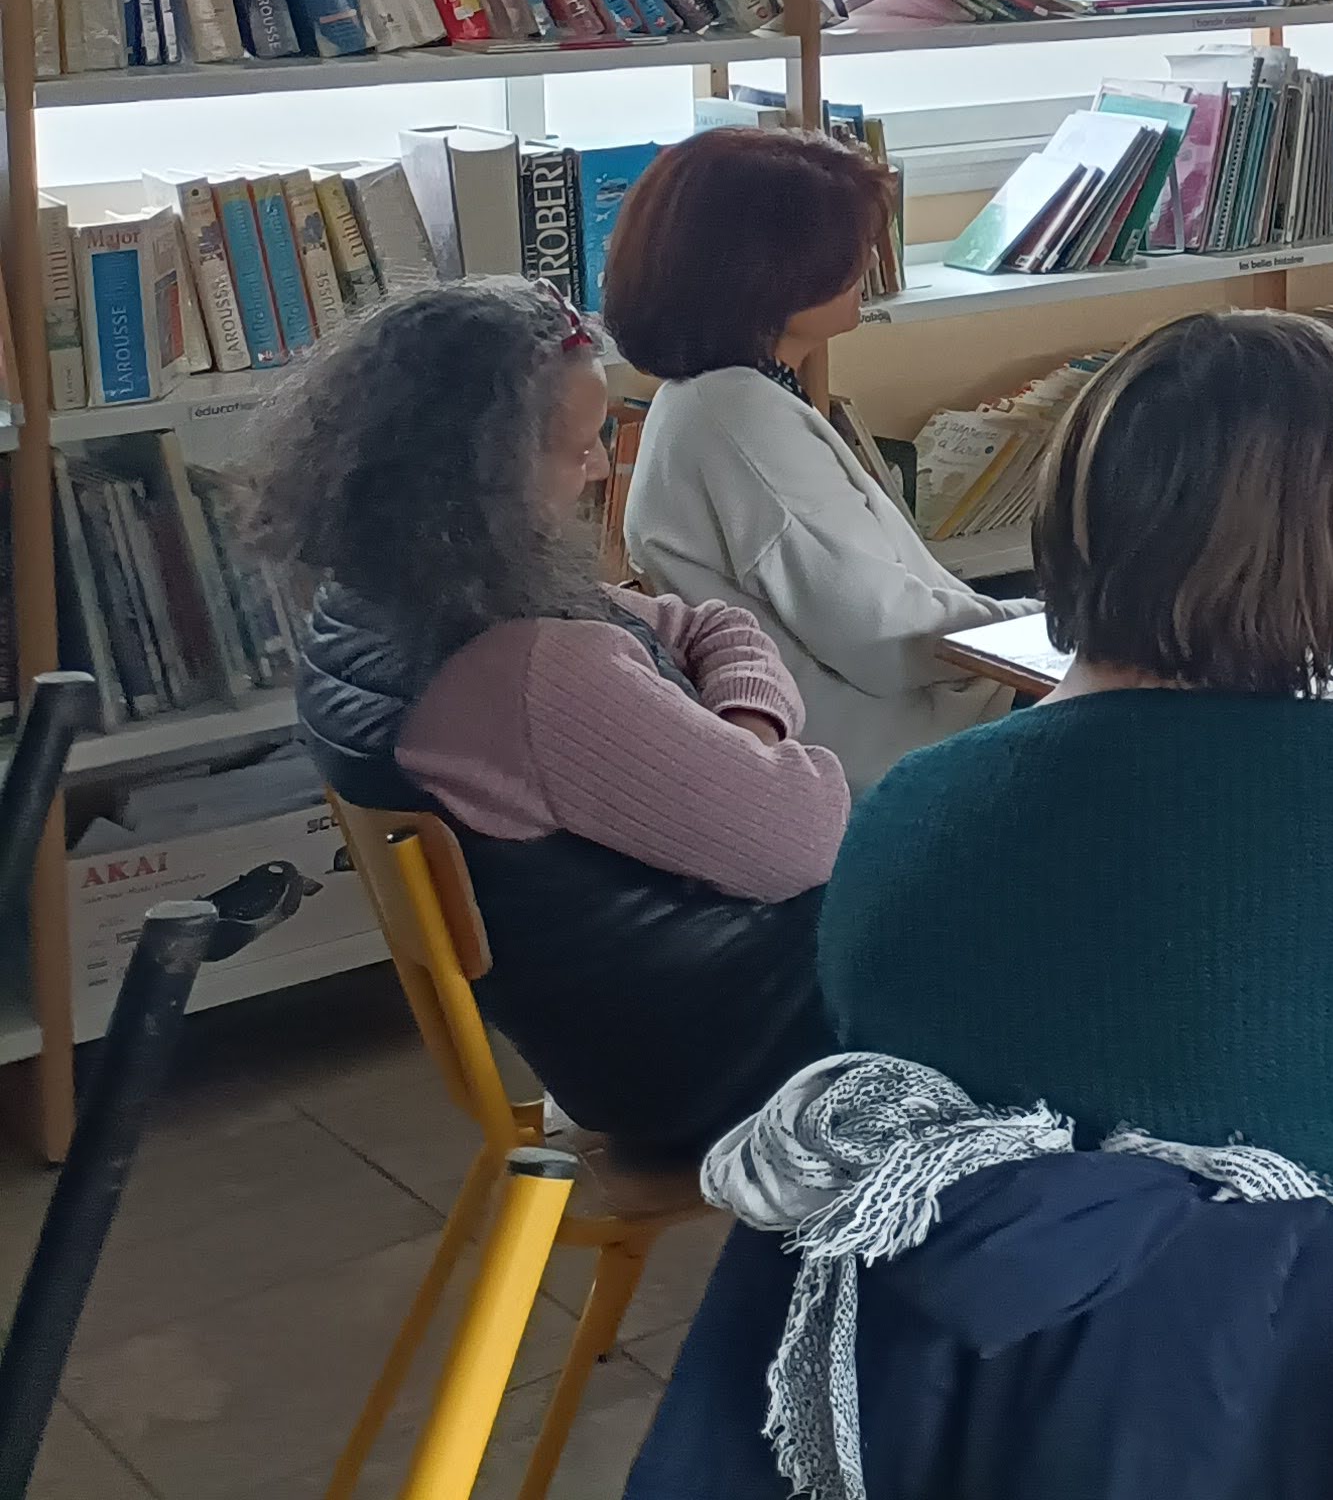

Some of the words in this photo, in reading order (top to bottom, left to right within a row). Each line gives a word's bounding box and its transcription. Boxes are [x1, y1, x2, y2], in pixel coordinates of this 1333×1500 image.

[532, 155, 570, 277] ROBERT
[112, 306, 134, 394] LAROUSSE
[81, 852, 168, 889] AKAI
